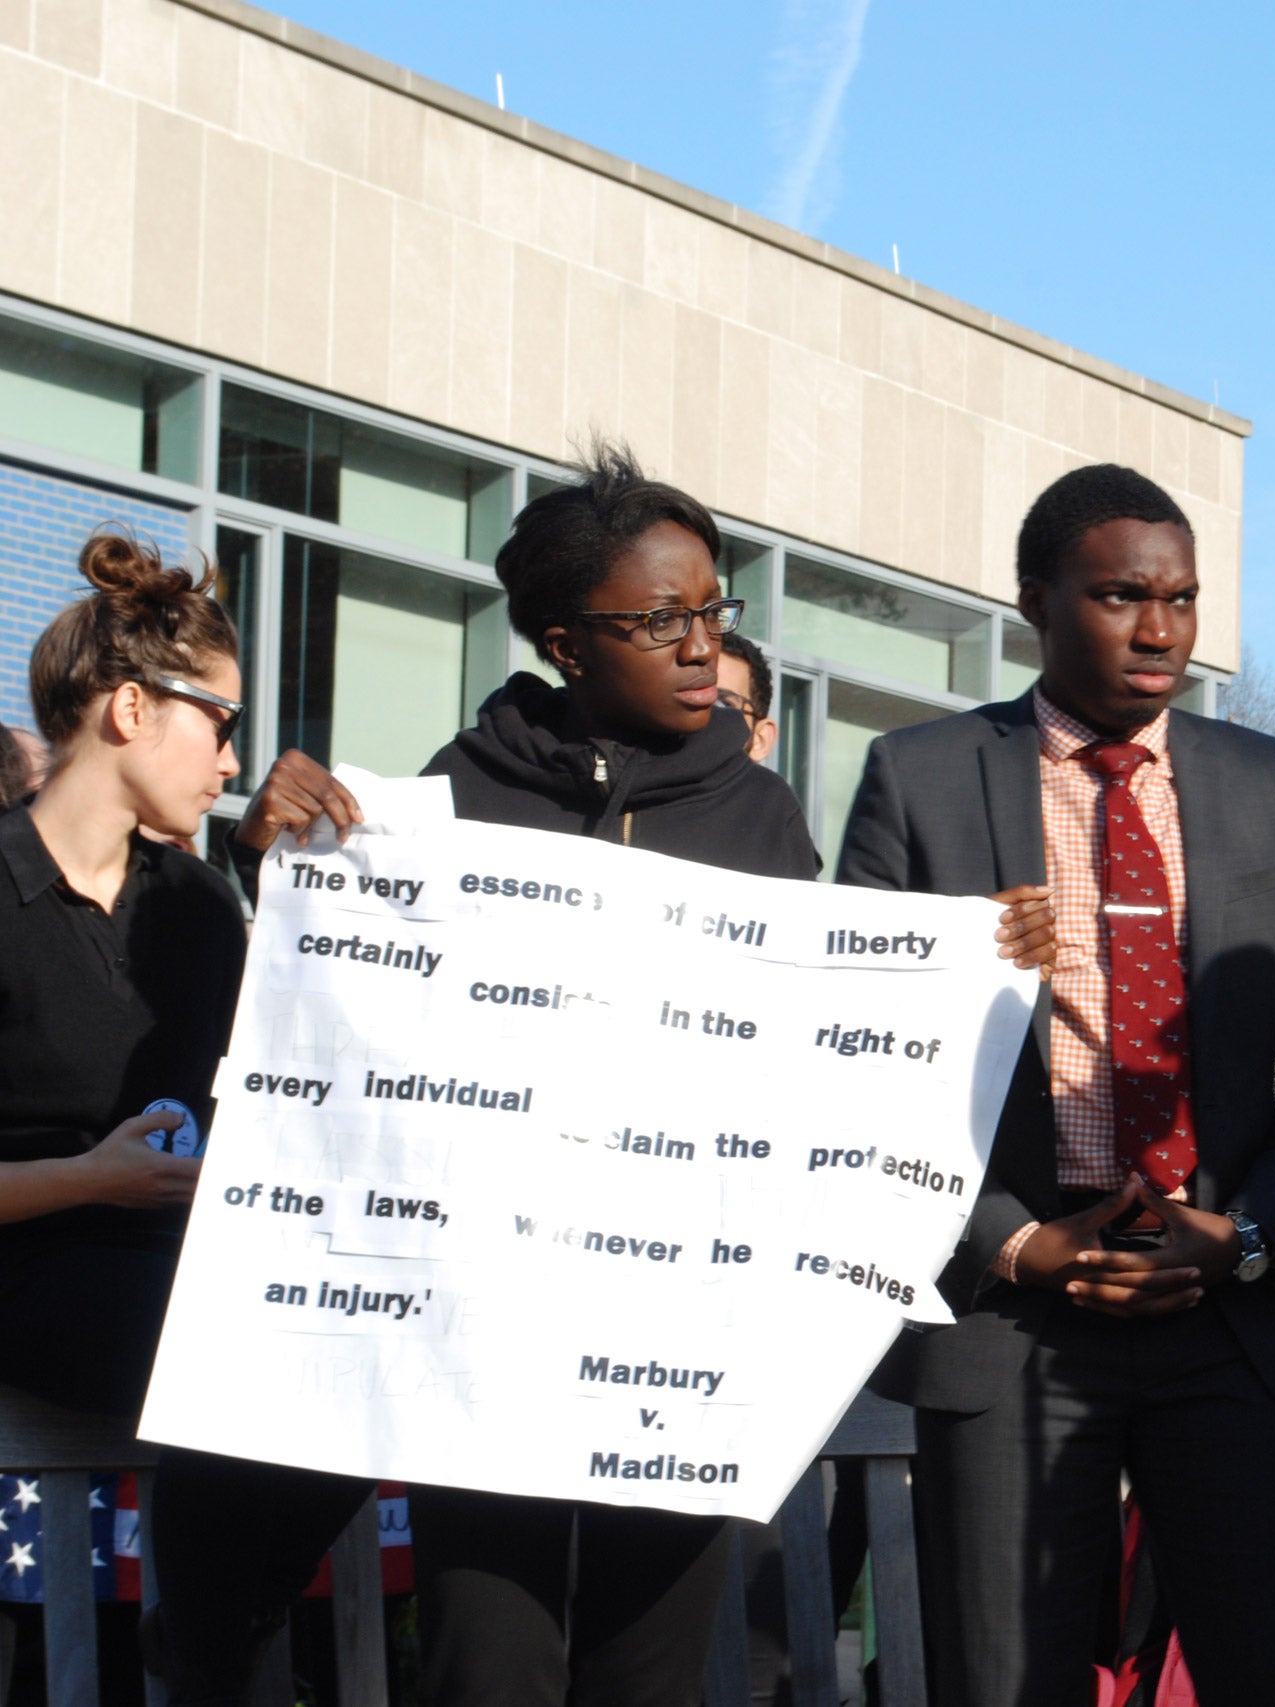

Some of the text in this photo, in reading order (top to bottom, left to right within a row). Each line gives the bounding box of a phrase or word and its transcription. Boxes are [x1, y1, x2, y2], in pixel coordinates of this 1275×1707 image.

[358, 876, 425, 907] very
[702, 913, 768, 947] civil
[827, 930, 938, 960] liberty
[298, 934, 942, 1064] certainly consi in the right of
[245, 1071, 965, 1196] every individual claim the protection
[225, 1183, 917, 1306] of the laws, wenever he receives
[265, 1284, 307, 1307] an
[579, 1356, 726, 1396] Marbury
[640, 1408, 666, 1431] v.
[589, 1452, 740, 1484] Madison
